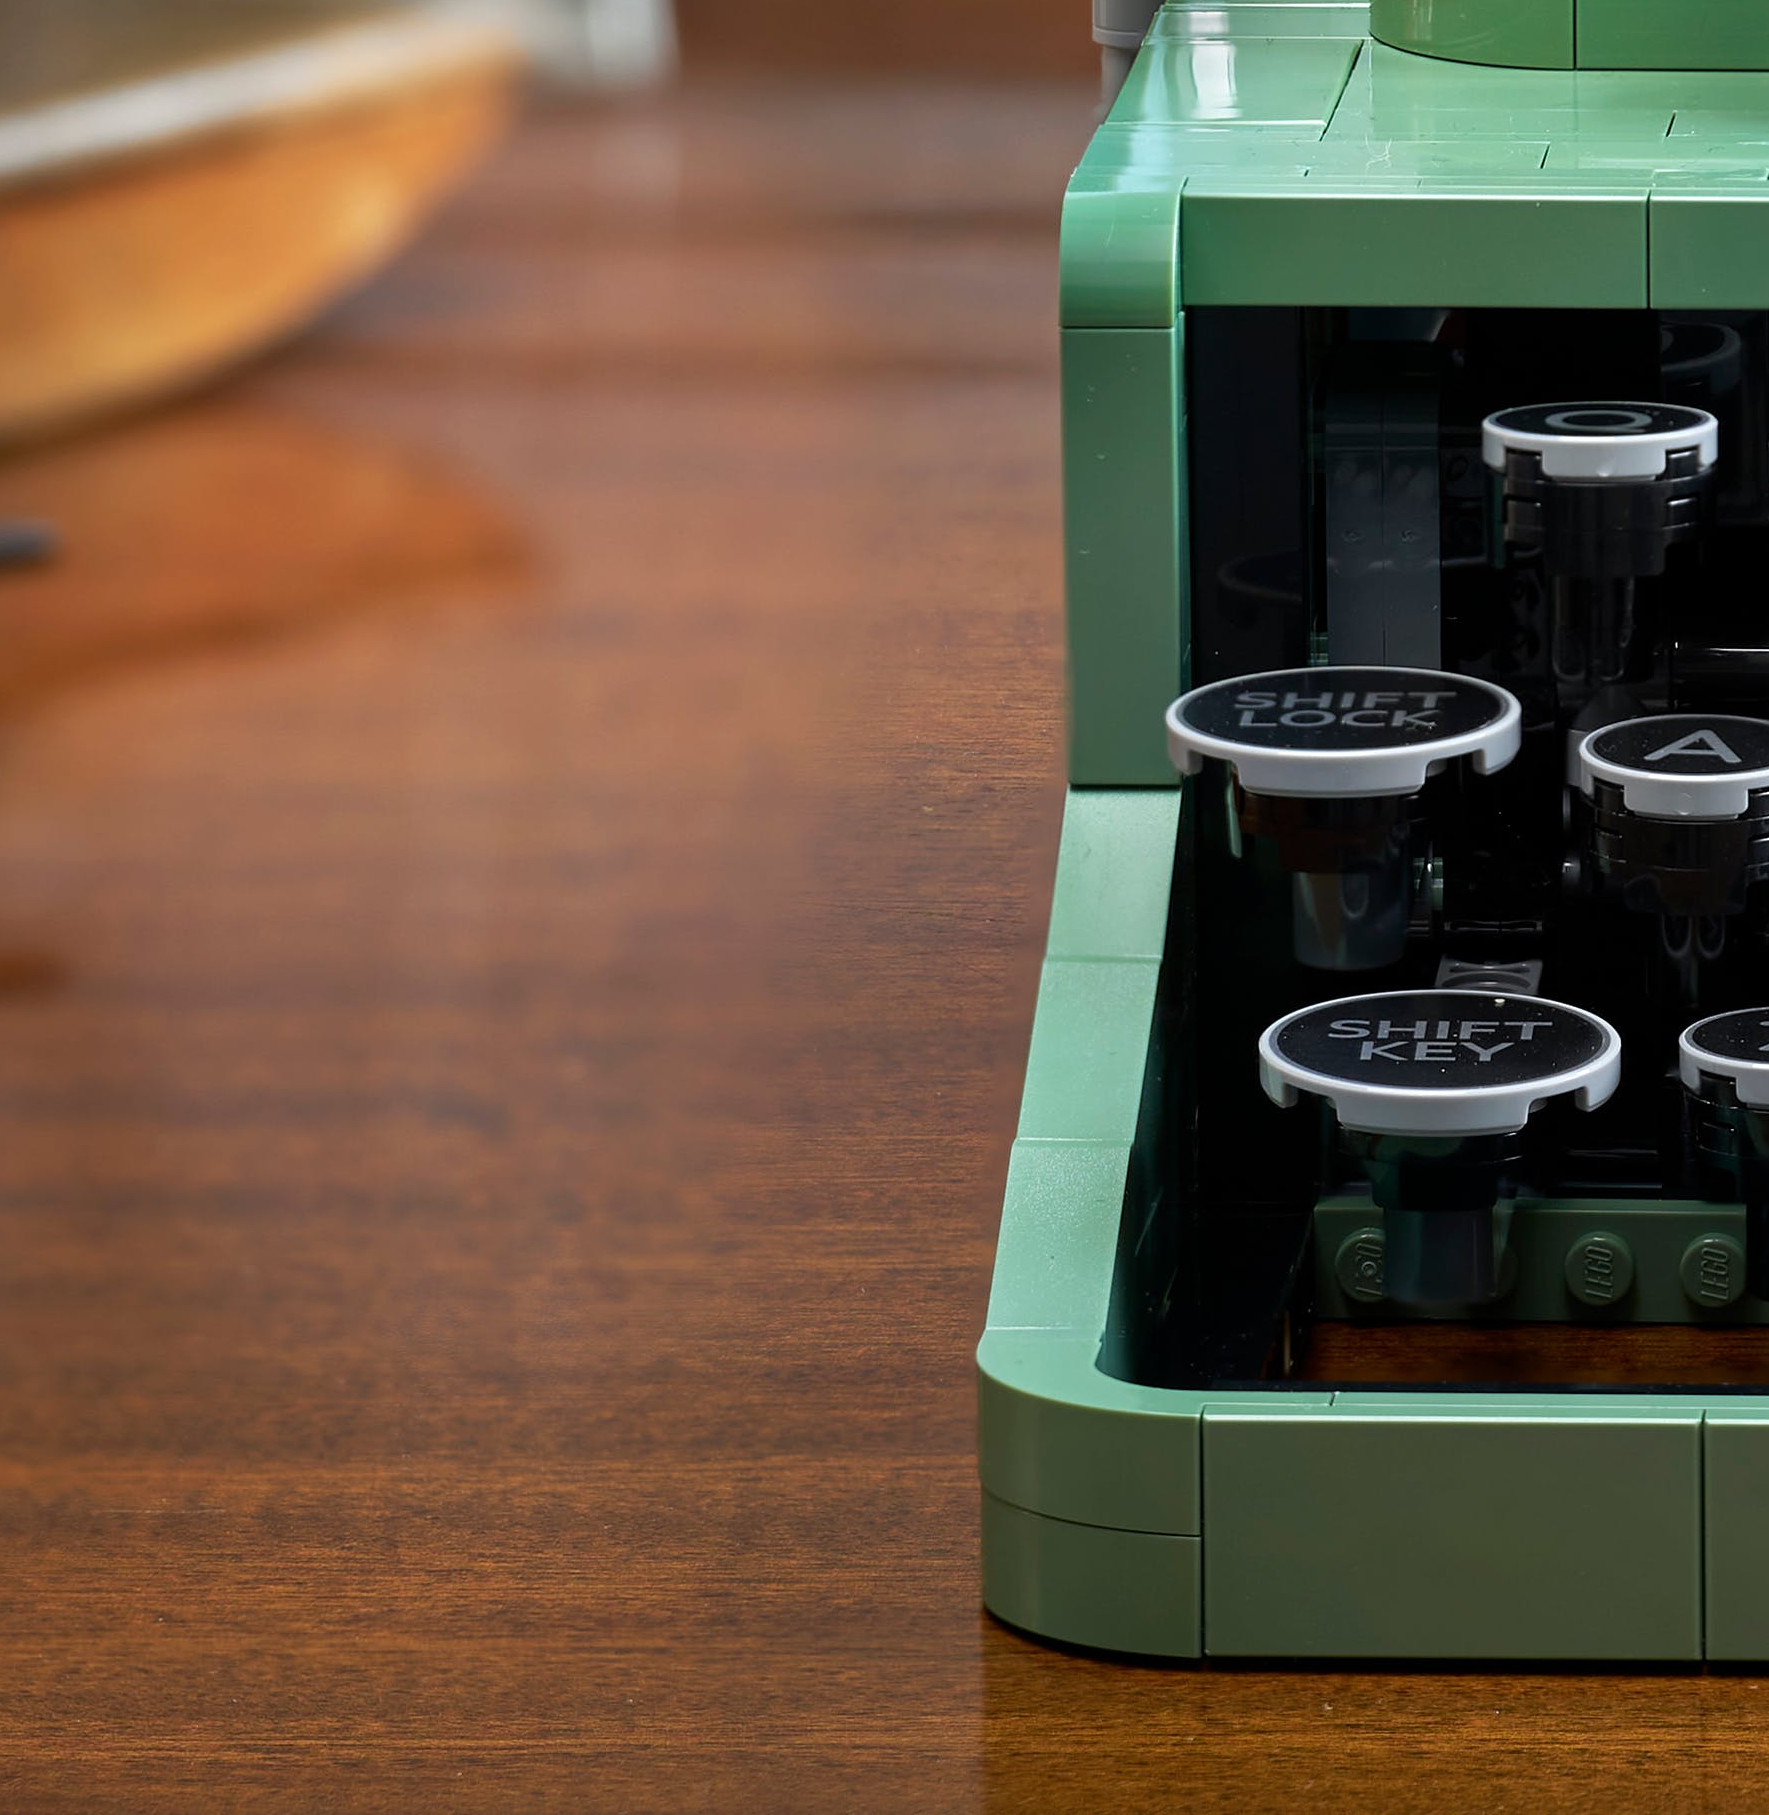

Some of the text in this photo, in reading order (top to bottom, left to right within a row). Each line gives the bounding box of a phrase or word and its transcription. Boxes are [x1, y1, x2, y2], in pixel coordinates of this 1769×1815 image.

[1544, 409, 1653, 433] Q
[1234, 691, 1456, 708] SHIFT
[1239, 710, 1438, 728] LOCK
[1644, 730, 1742, 763] A
[1328, 1020, 1552, 1040] SHIFT
[1360, 1041, 1514, 1061] KEY
[1584, 1245, 1614, 1298] LEGO
[1700, 1247, 1729, 1301] LEGO
